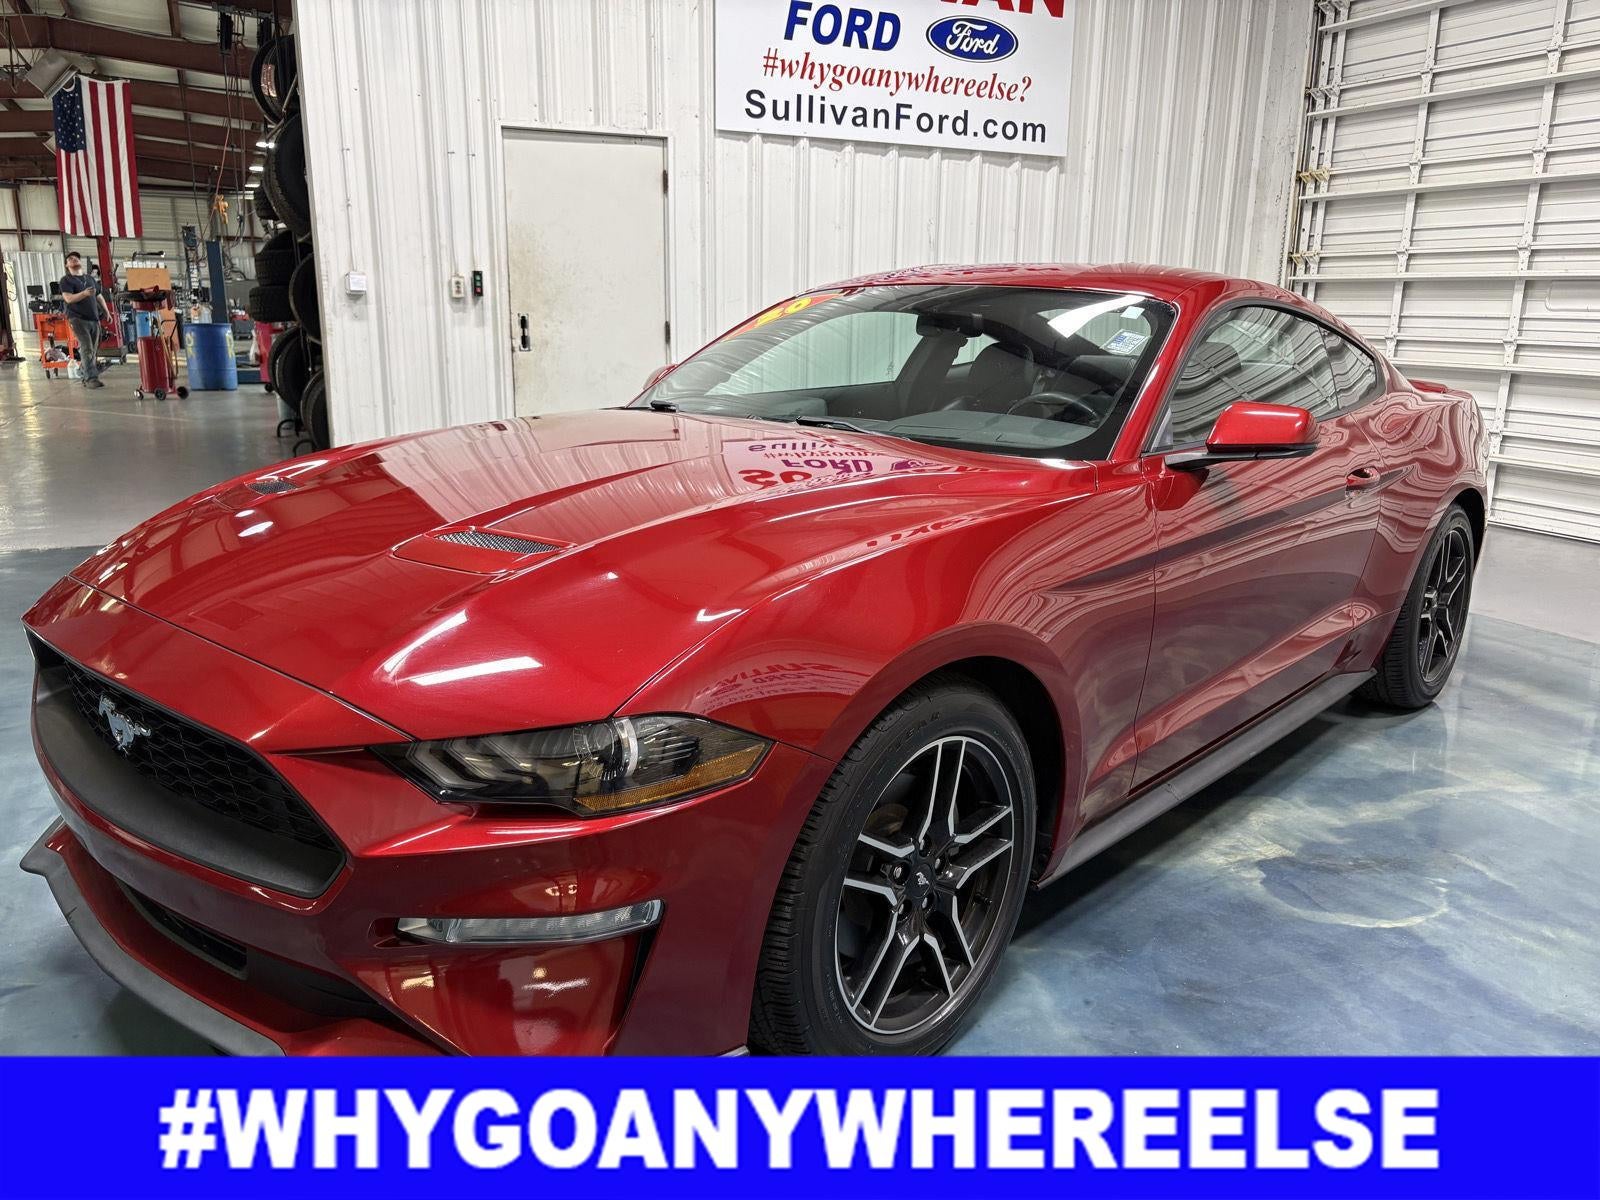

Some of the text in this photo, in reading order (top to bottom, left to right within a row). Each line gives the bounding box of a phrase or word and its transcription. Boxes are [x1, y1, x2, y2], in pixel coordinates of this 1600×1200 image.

[784, 0, 901, 51] FORD
[945, 21, 1000, 55] Ford
[763, 47, 1032, 102] #whygoanywhereelse?
[744, 89, 1046, 143] SullivanFord.com
